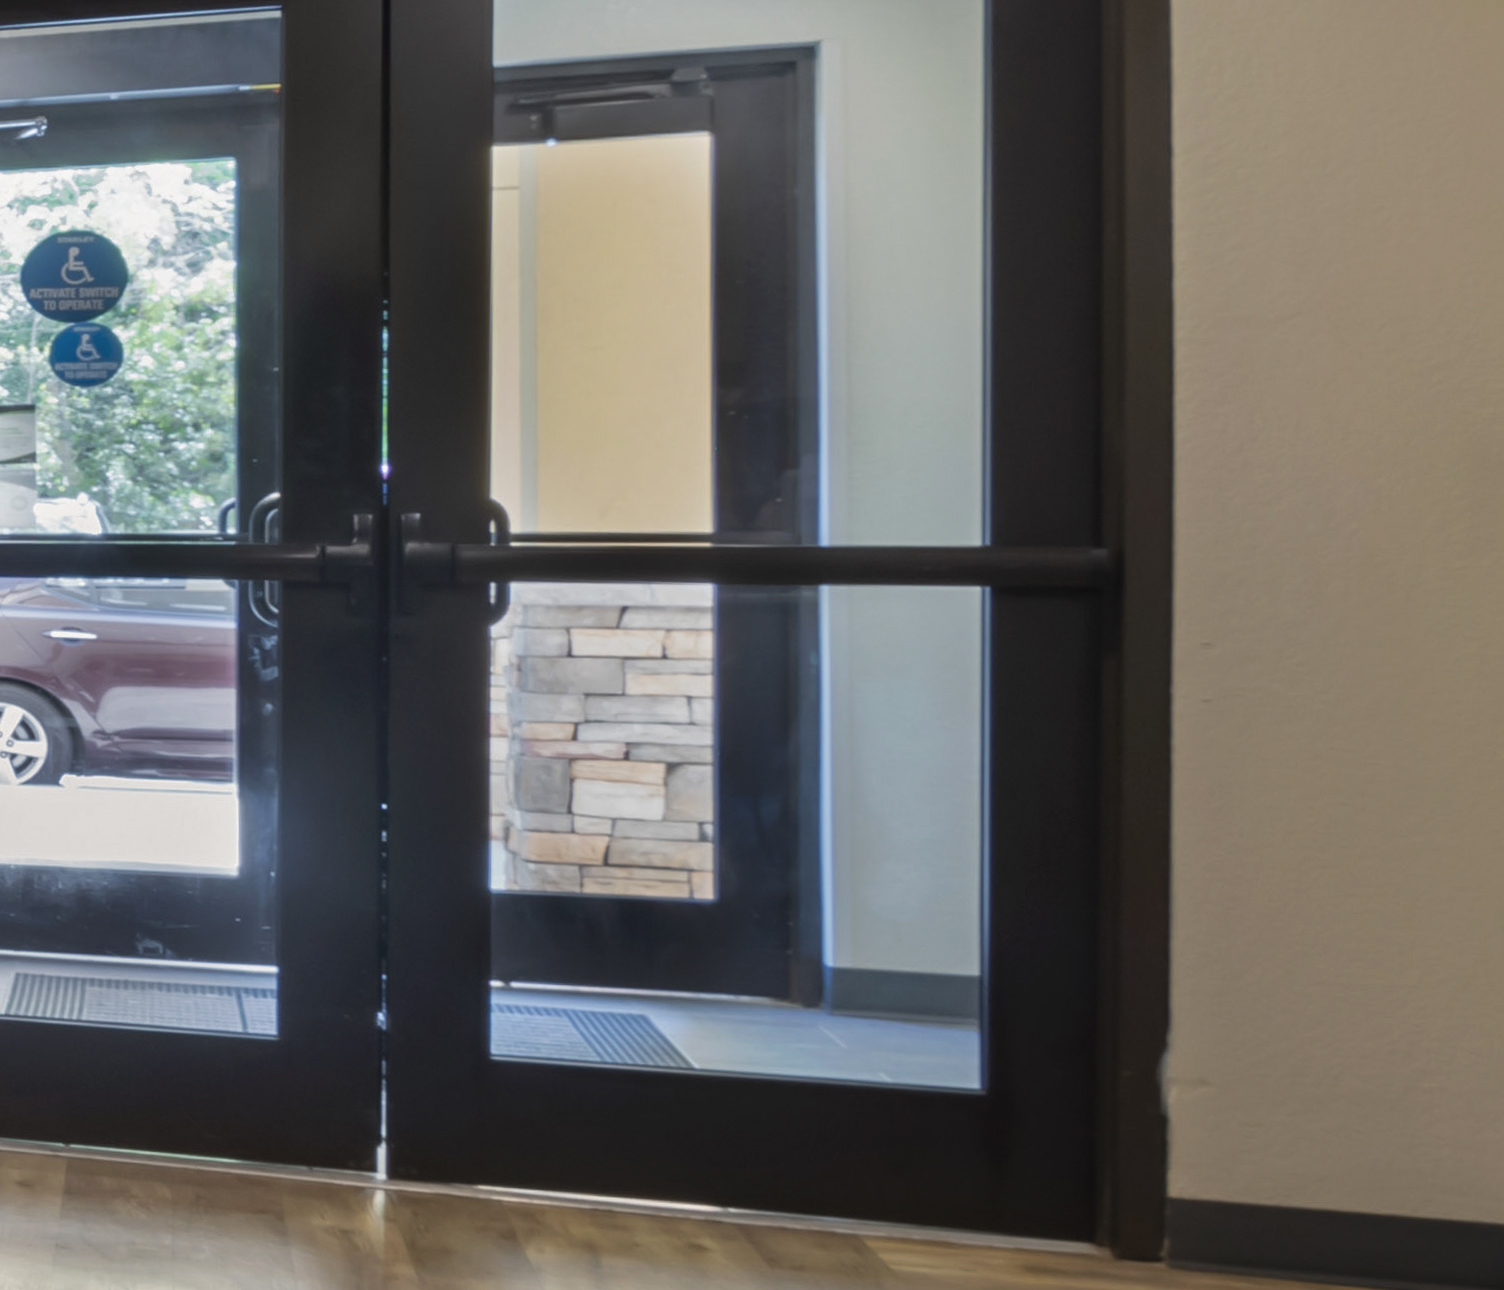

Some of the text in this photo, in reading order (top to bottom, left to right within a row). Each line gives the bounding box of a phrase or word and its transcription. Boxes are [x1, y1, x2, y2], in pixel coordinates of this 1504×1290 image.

[29, 286, 119, 299] ACTIVATE SWITCH
[43, 299, 104, 311] TO OPERATE
